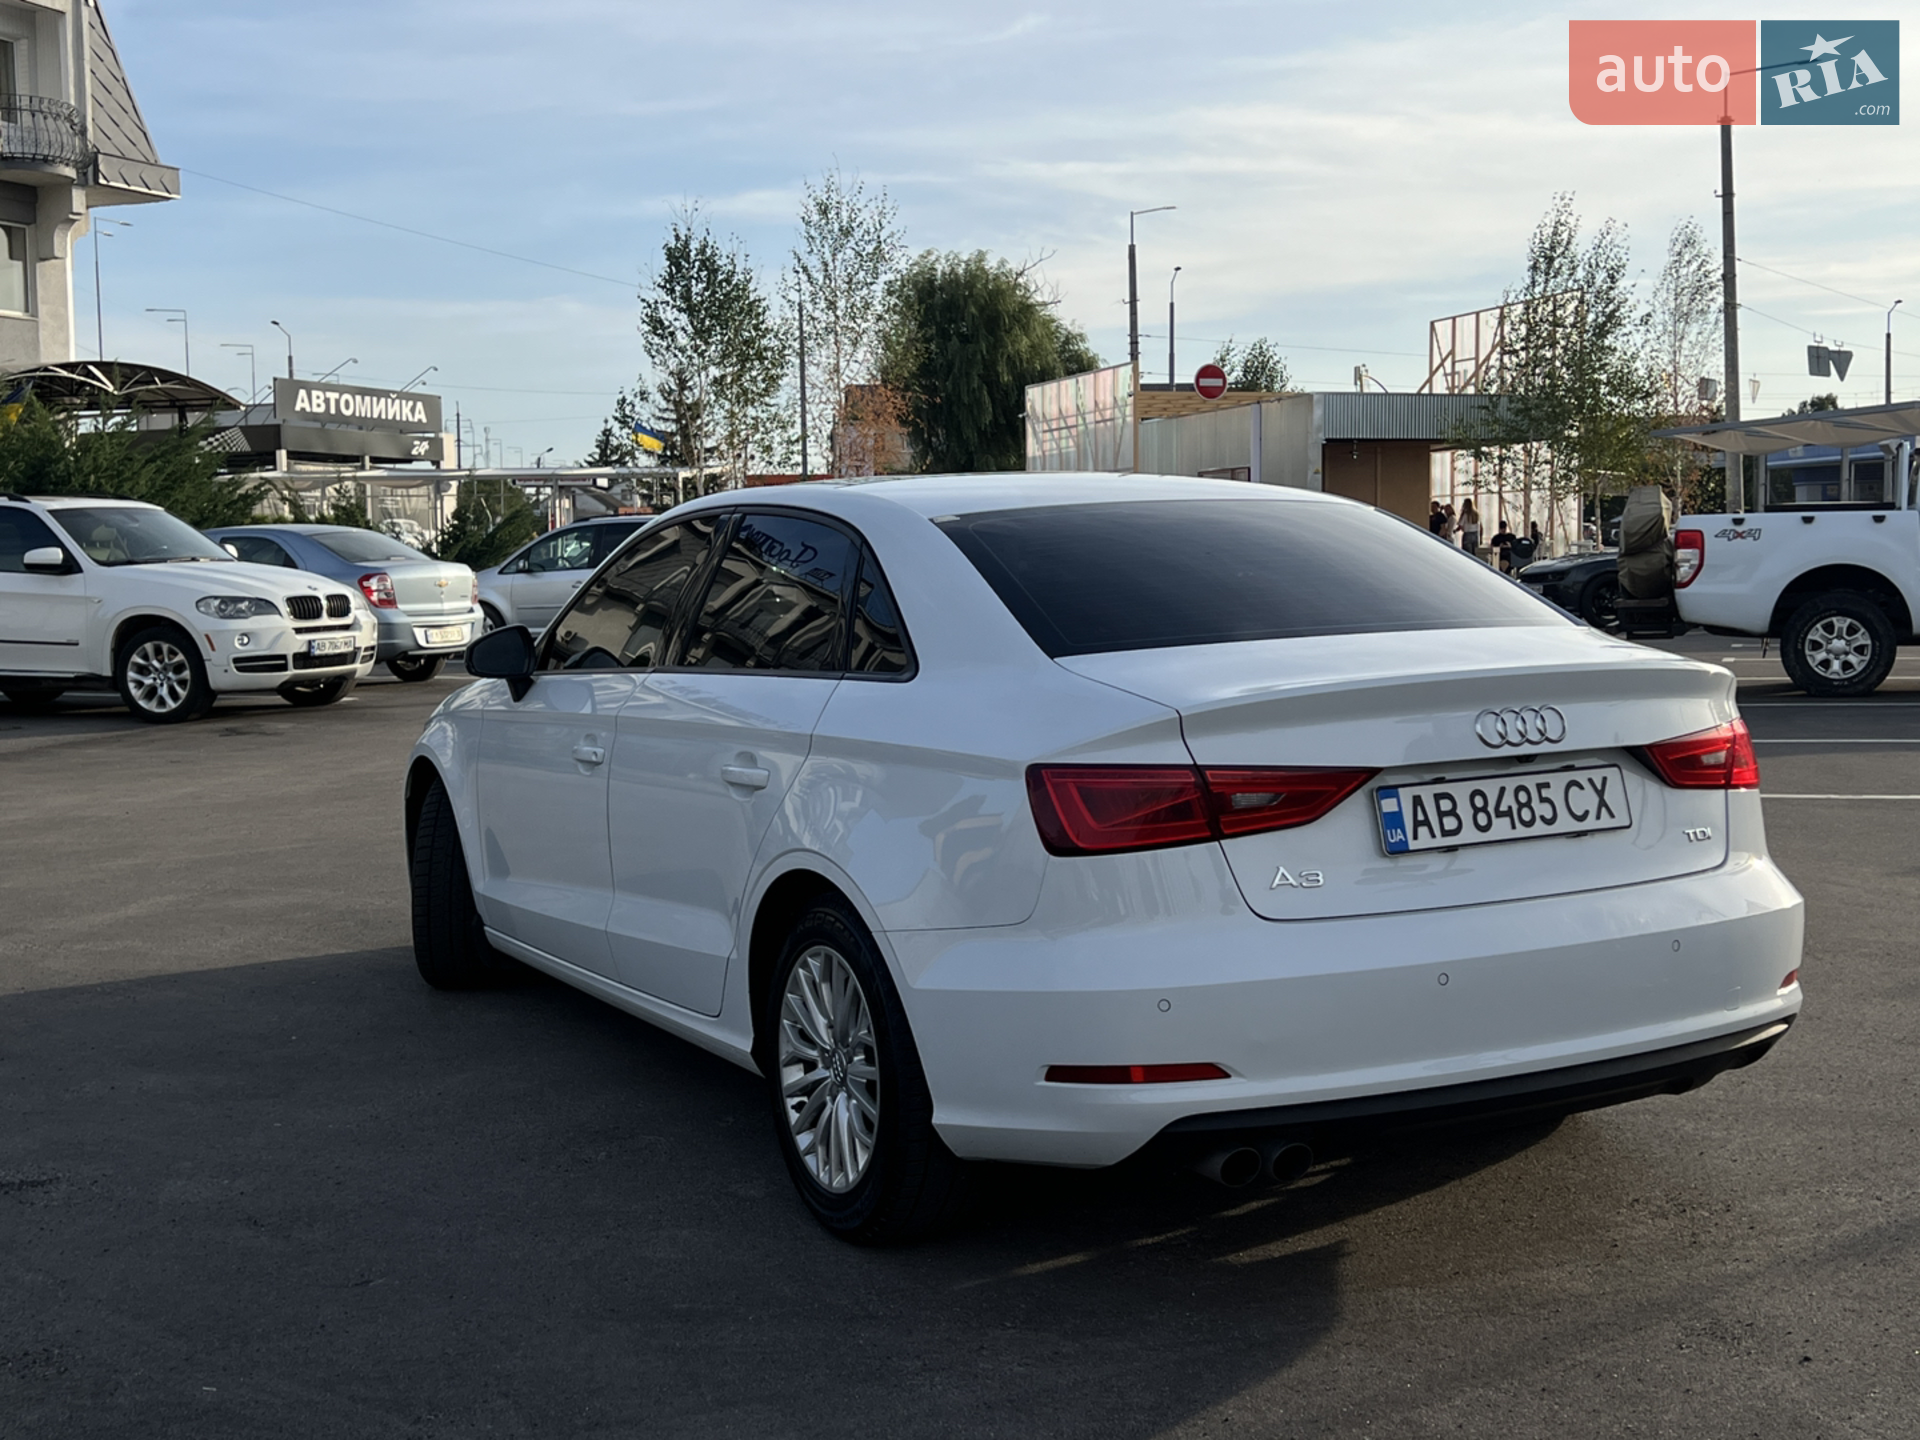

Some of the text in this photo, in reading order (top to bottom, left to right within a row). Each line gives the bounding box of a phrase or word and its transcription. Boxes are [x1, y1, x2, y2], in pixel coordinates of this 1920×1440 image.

[294, 388, 428, 424] АВТОМИЙКА
[1412, 775, 1616, 841] AB 8485 CX
[1387, 828, 1406, 843] UA
[1682, 827, 1712, 843] TDI
[1269, 866, 1325, 891] A3
